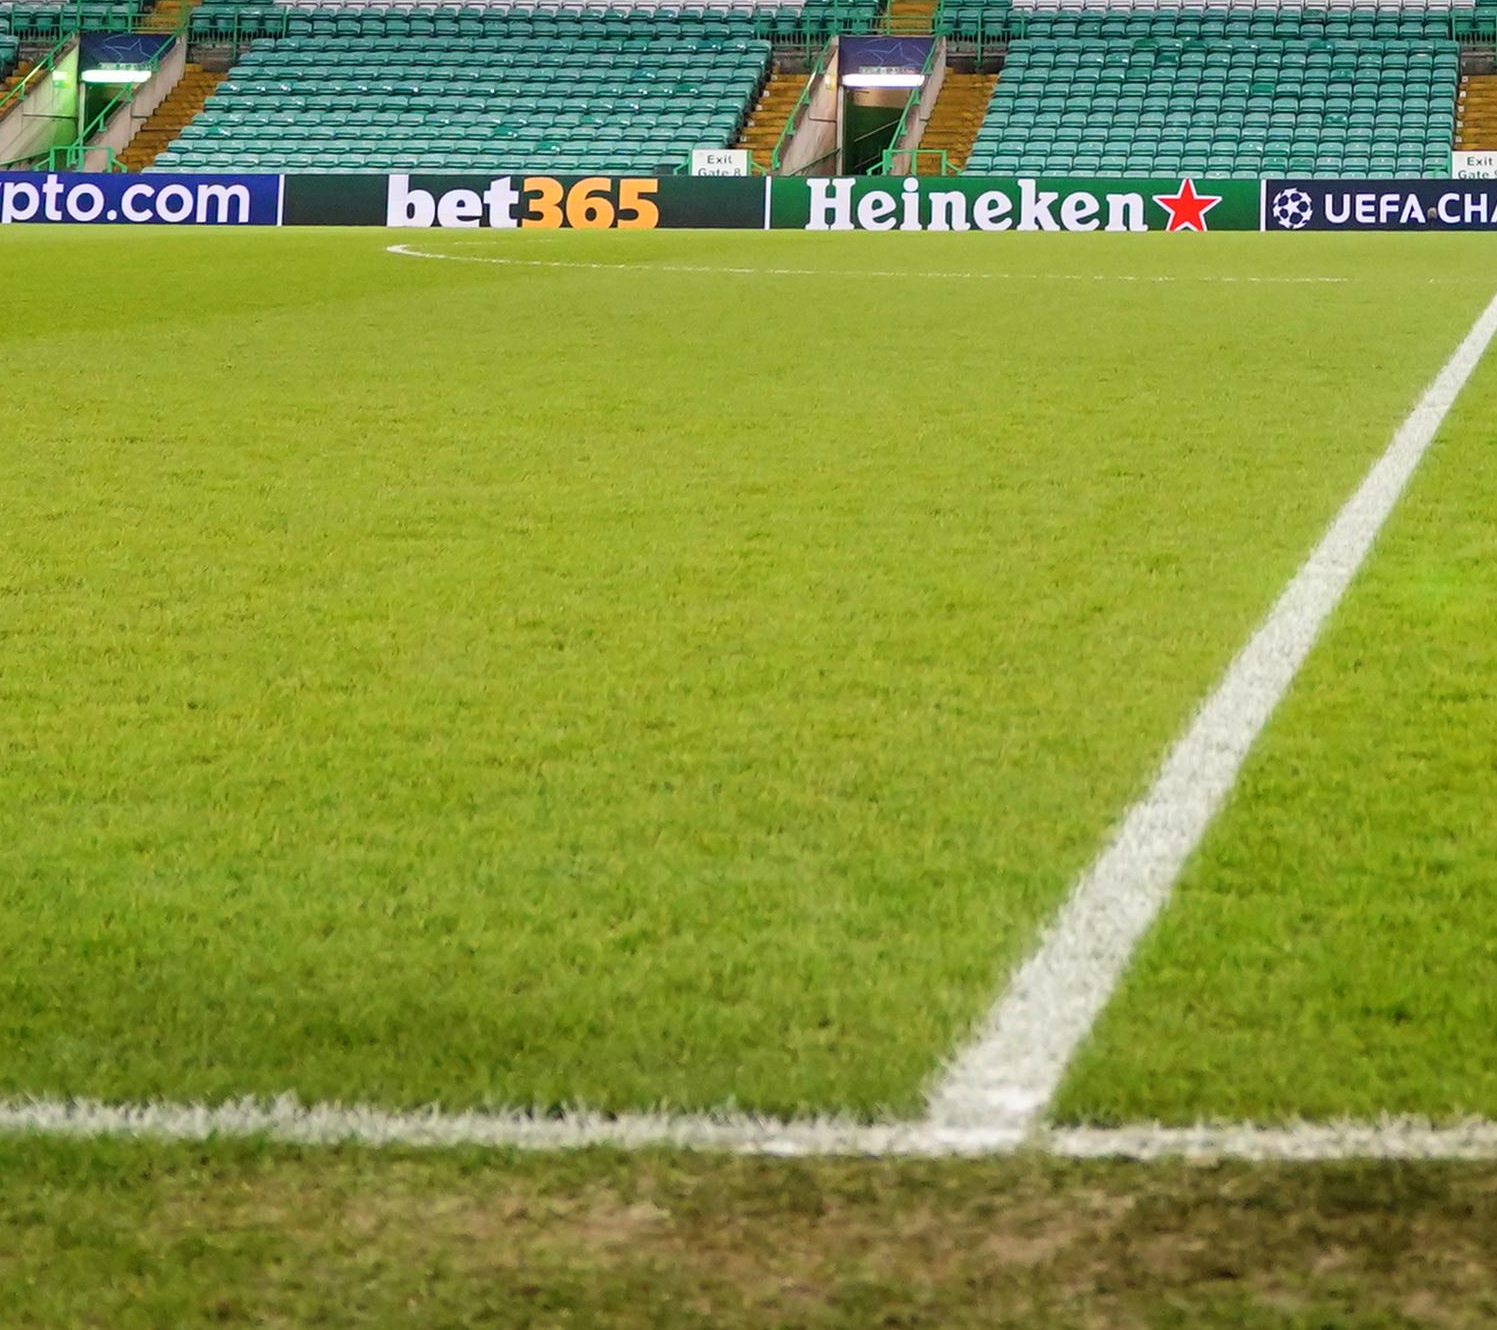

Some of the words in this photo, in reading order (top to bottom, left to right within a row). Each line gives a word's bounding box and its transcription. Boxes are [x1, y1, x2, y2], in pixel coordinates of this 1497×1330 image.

[707, 155, 732, 165] Exit
[1466, 157, 1493, 167] Exit
[697, 168, 729, 177] Gate
[733, 168, 741, 177] 8
[1457, 170, 1490, 180] Gate
[387, 174, 660, 230] bet365
[806, 177, 1149, 232] Heineken
[1324, 193, 1426, 225] UEFA
